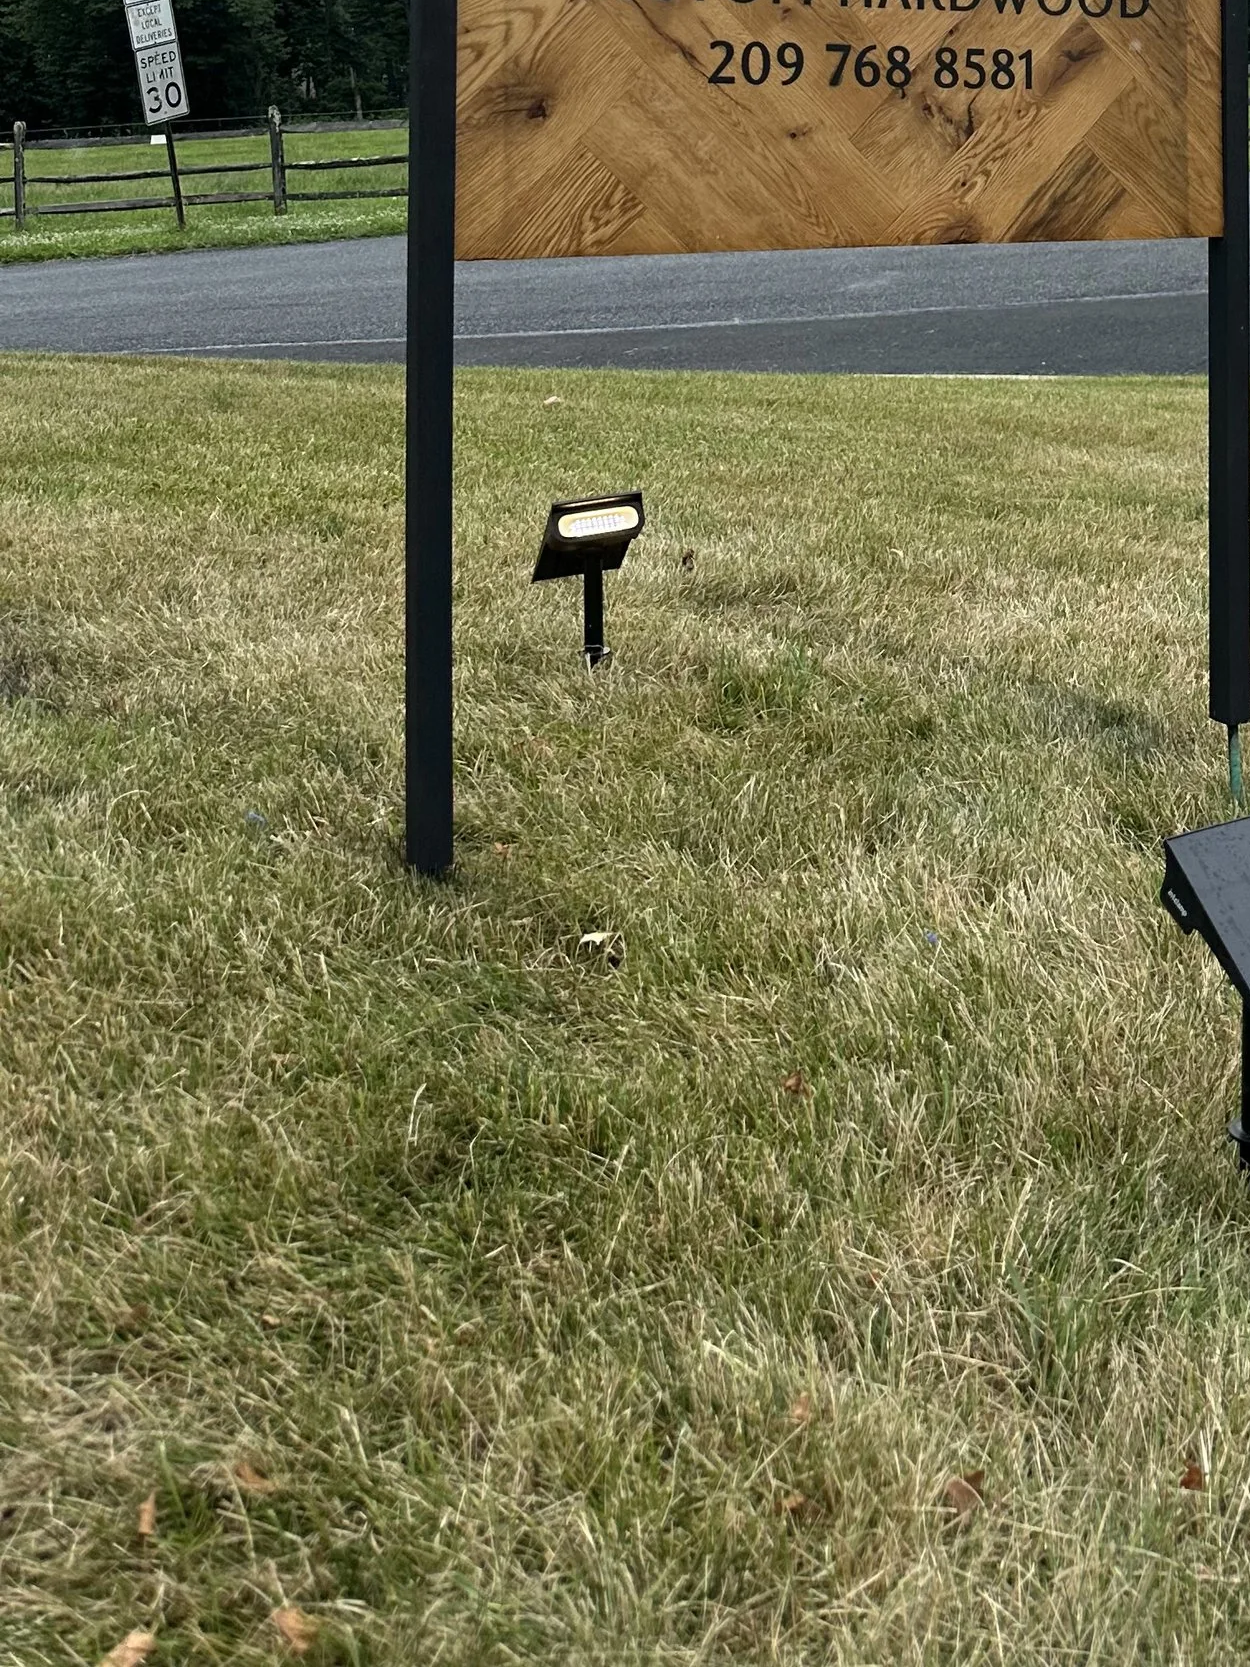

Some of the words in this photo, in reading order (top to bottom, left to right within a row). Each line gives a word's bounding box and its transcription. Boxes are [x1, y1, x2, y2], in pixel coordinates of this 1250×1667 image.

[137, 4, 162, 18] EXCEPT
[141, 18, 162, 30] LOCAL
[136, 28, 172, 44] DELIVERIES
[140, 51, 176, 69] SPEED
[707, 40, 804, 87] 209
[825, 43, 912, 90] 768
[934, 47, 1034, 90] 8581
[146, 67, 174, 83] LIMIT
[146, 81, 182, 114] 30
